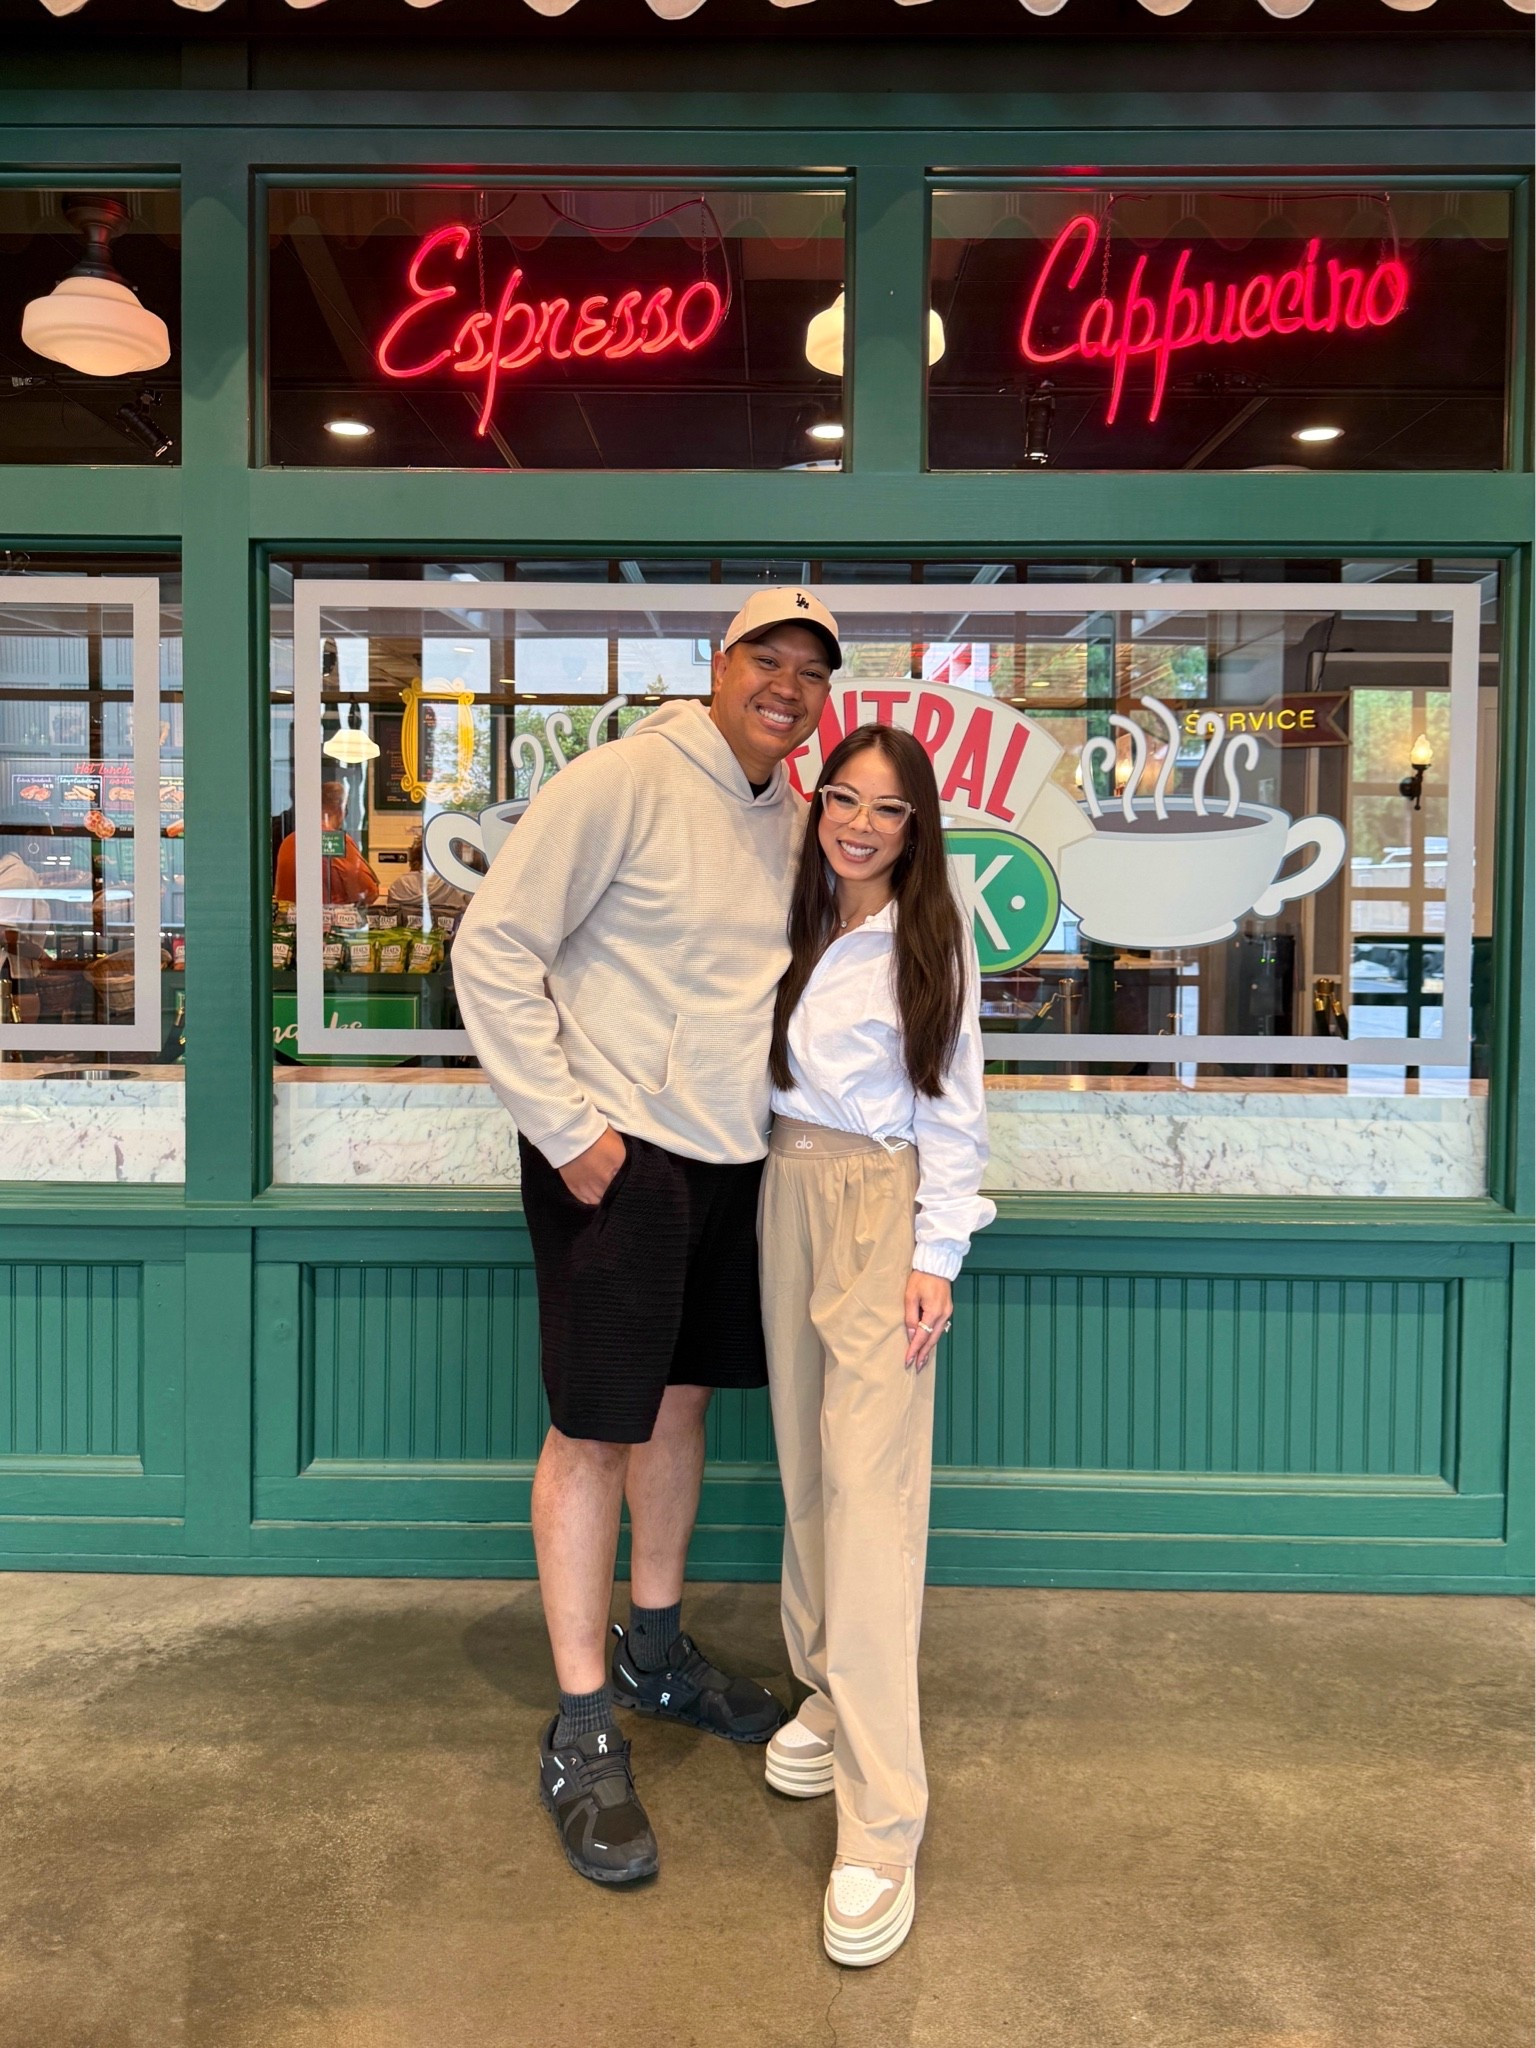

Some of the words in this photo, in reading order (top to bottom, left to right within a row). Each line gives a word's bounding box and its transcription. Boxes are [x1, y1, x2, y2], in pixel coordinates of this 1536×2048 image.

[378, 225, 721, 435] Espresso
[1020, 216, 1408, 424] Cappuccino
[73, 762, 95, 775] Hot
[97, 764, 132, 775] Lunch
[785, 689, 1030, 823] ENTRAL
[795, 1134, 813, 1149] alo
